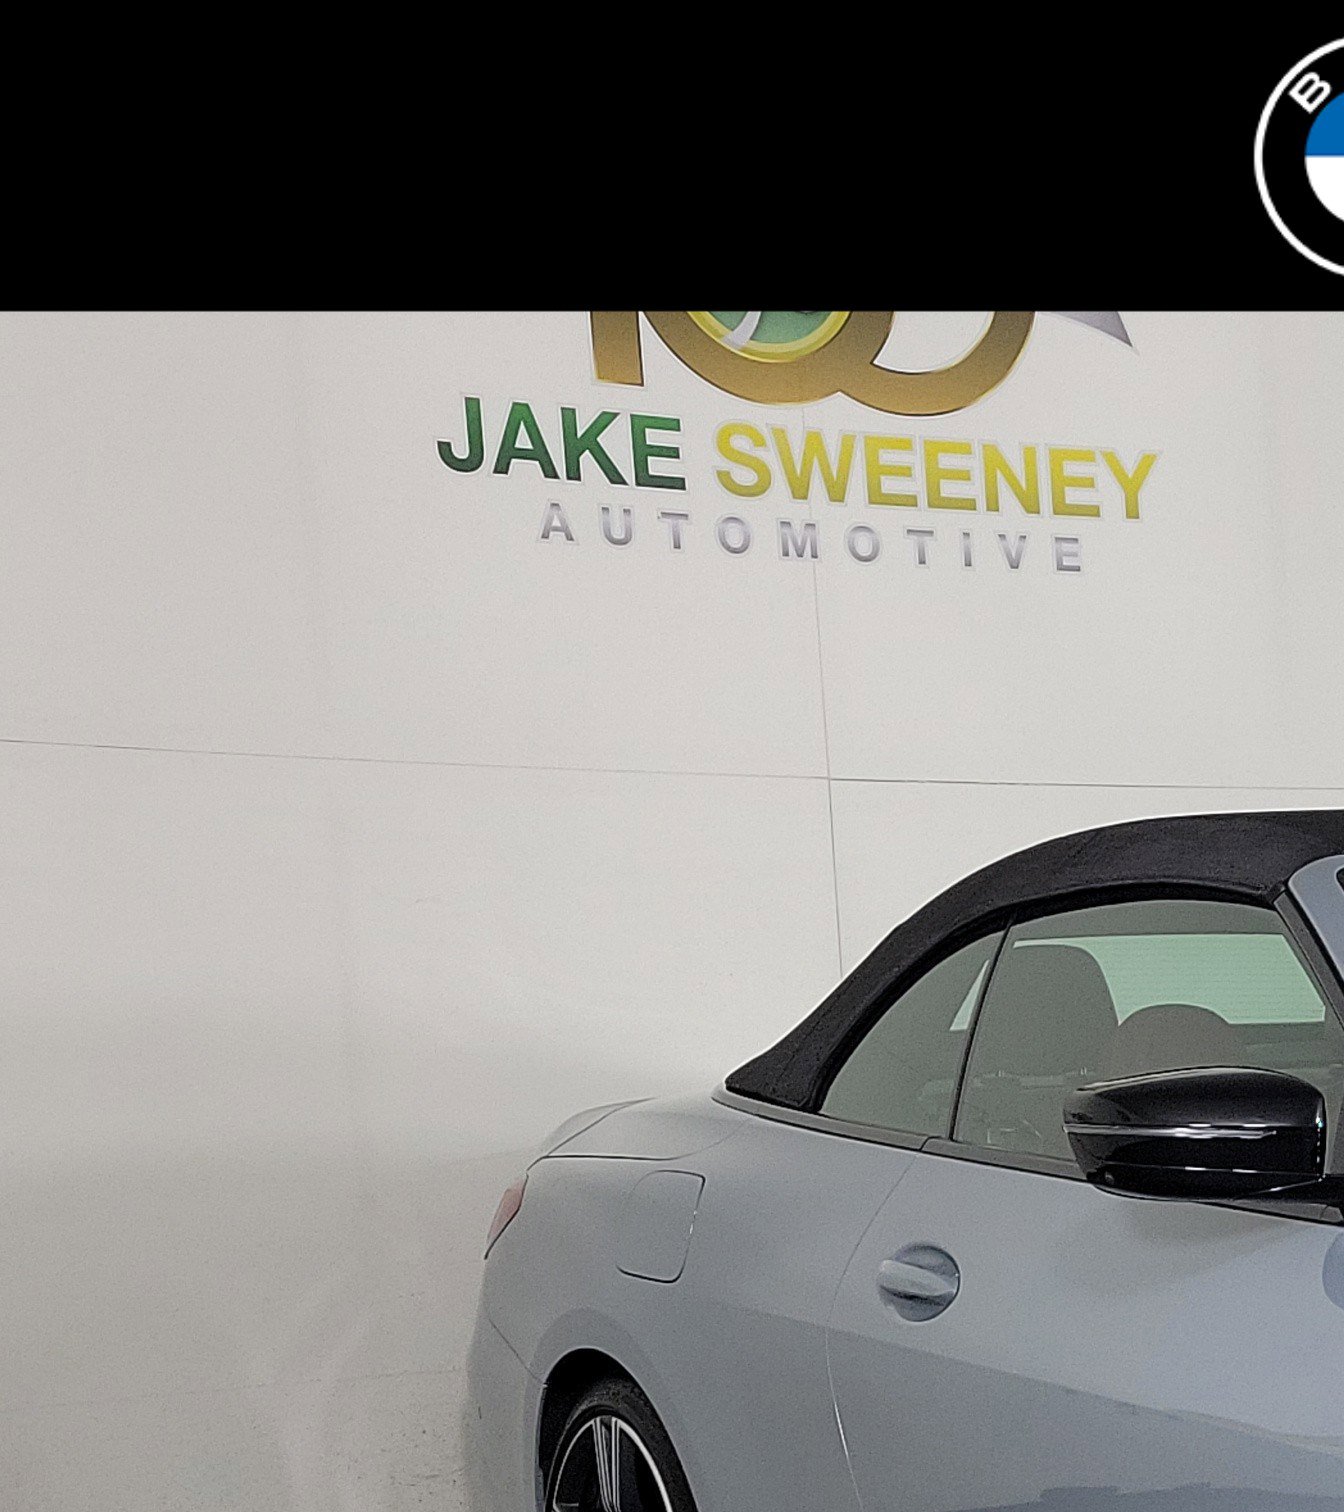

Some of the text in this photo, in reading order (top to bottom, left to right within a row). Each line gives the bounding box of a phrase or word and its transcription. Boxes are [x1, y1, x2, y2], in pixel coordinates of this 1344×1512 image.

[436, 396, 1158, 520] JAKE SWEENEY
[539, 502, 1083, 573] AUTOMOTIVE
